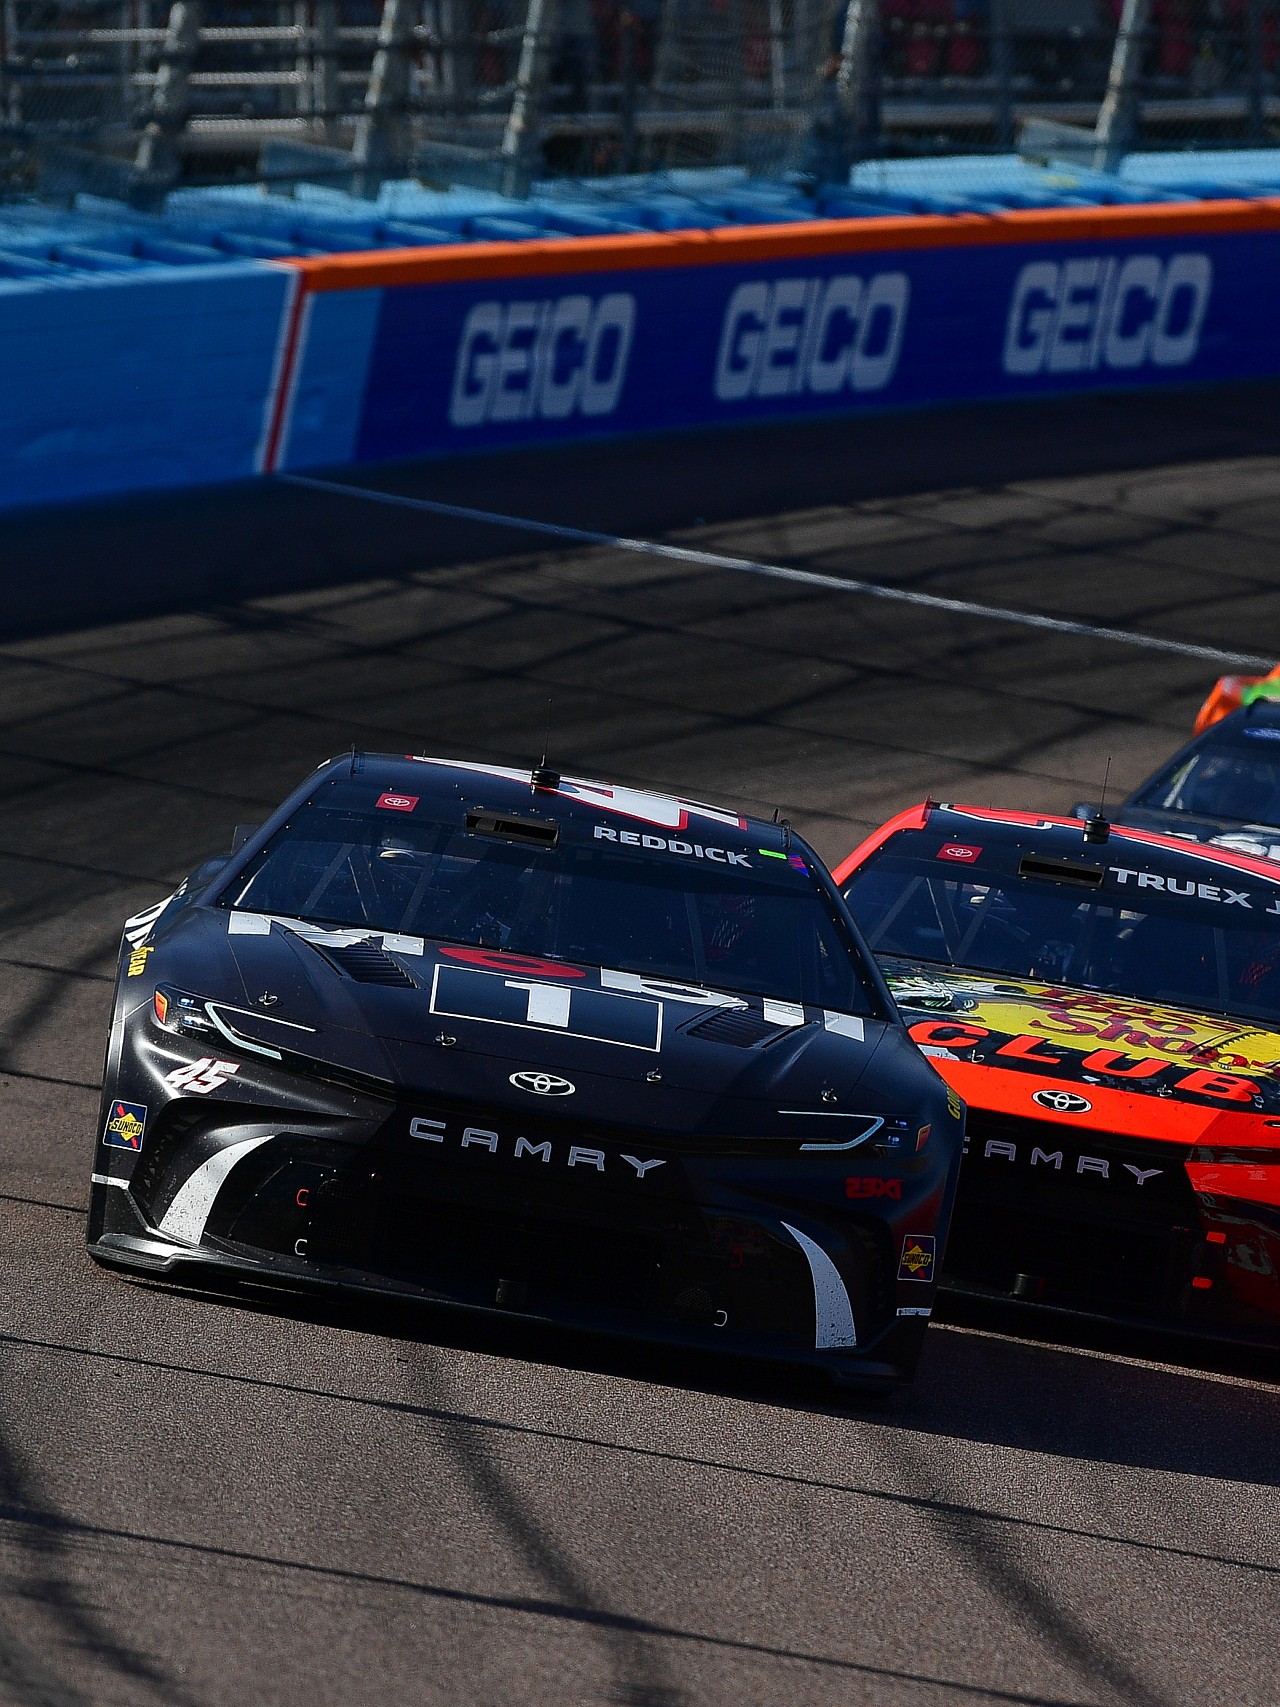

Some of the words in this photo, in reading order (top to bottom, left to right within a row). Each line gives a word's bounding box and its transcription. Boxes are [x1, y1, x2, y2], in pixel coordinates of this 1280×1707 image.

[713, 272, 910, 400] GEICO
[1003, 254, 1212, 374] GEICO
[449, 293, 636, 426] GEICO
[593, 824, 754, 868] REDDICK
[1108, 866, 1254, 909] TRUEX
[164, 1057, 241, 1095] 45
[906, 1020, 1264, 1104] CLUB
[110, 1119, 143, 1136] SUNOCO
[408, 1117, 668, 1179] CAMRY
[902, 1252, 931, 1266] SUNOCO
